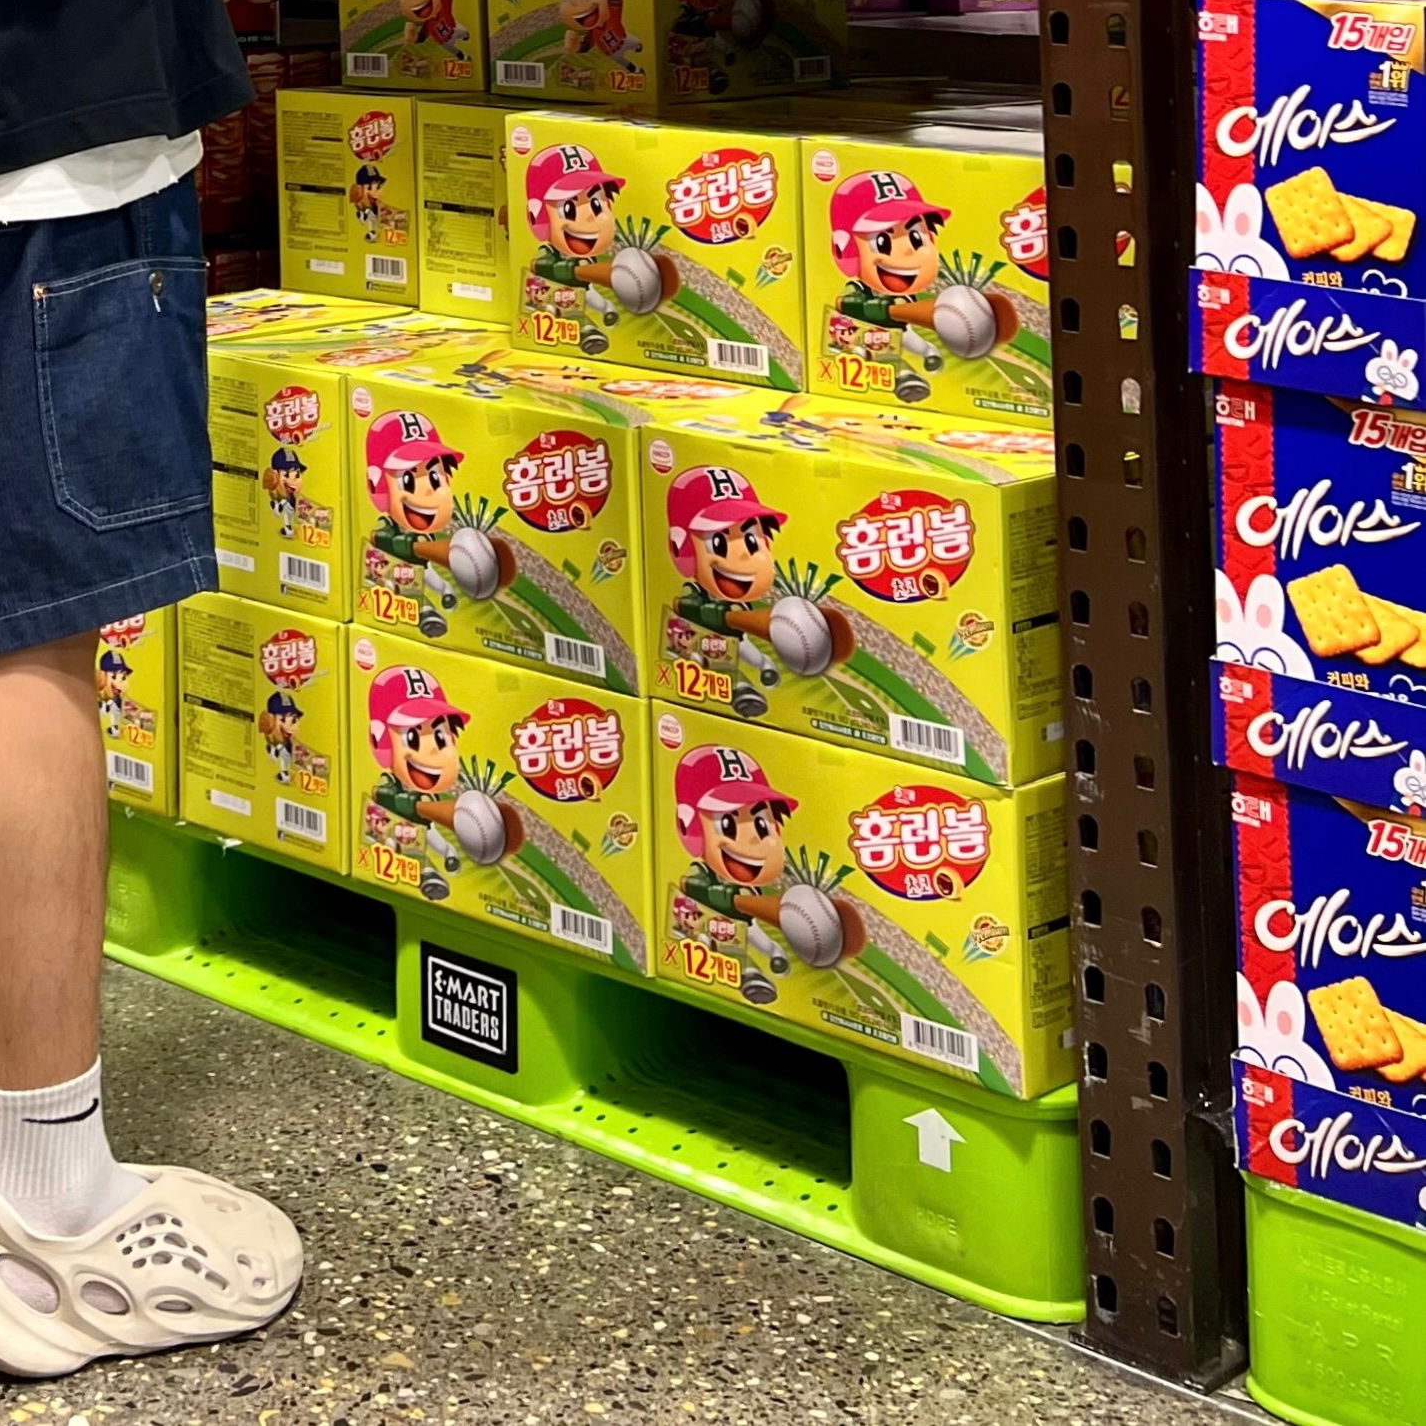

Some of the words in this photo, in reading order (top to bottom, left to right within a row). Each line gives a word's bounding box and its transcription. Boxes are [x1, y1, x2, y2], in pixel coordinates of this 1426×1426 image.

[1328, 12, 1415, 55] 15개입
[442, 58, 472, 80] 12개입
[609, 70, 645, 92] 12개입
[1379, 60, 1410, 92] 1위
[349, 115, 394, 152] 홈런볼
[1215, 84, 1397, 167] 에이스
[562, 146, 588, 171] H
[668, 157, 774, 223] 홈런볼
[871, 173, 904, 200] H
[710, 223, 732, 242] 초코
[533, 313, 580, 343] 12개입
[1223, 298, 1381, 370] 에이스
[838, 355, 894, 388] 12개입
[266, 395, 320, 431] 홈런볼
[1216, 395, 1256, 421] 해태
[400, 413, 425, 439] H
[507, 446, 609, 507] 홈런볼
[708, 470, 740, 500] H
[302, 524, 331, 546] 12개입
[548, 511, 570, 530] 초코
[1235, 479, 1422, 561] 에이스
[840, 501, 972, 577] 홈런볼
[373, 587, 418, 624] 12개입
[892, 578, 916, 600] 초코
[261, 632, 316, 673] 홈런볼
[404, 669, 431, 697] H
[675, 660, 731, 700] 12개입
[1326, 670, 1370, 691] 커피와
[514, 715, 621, 774] 홈런볼
[1247, 699, 1409, 771] 에이스
[718, 748, 750, 781] H
[299, 771, 327, 795] 12개입
[556, 778, 576, 799] 초코
[1231, 791, 1272, 823] 해태
[853, 803, 989, 870] 홈런볼
[1366, 819, 1426, 869] 15개
[373, 845, 421, 885] 12개입
[904, 875, 931, 897] 초코
[1254, 888, 1426, 971] 에이스
[683, 940, 740, 987] 12개입
[434, 969, 501, 1012] E-MART
[434, 994, 500, 1041] TRADERS
[1348, 1086, 1393, 1108] 커피와
[1269, 1111, 1426, 1180] 에이스
